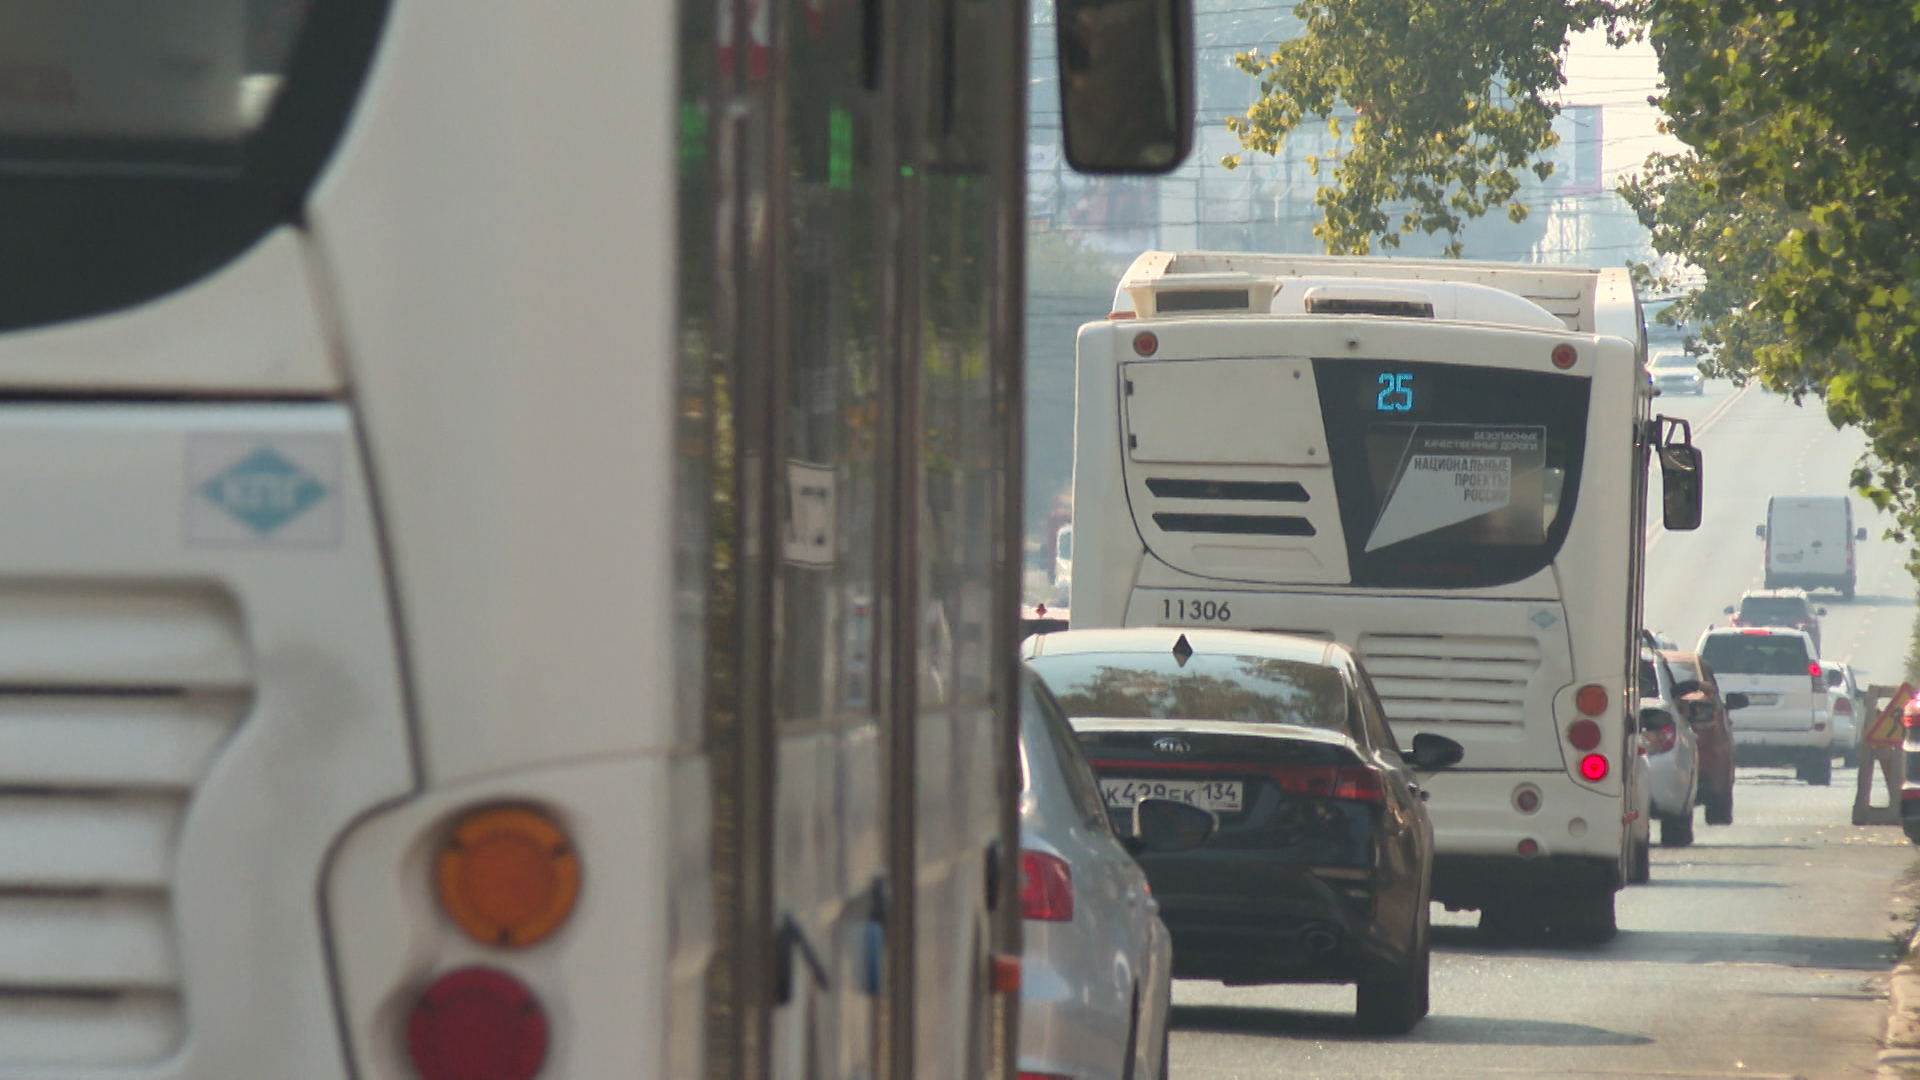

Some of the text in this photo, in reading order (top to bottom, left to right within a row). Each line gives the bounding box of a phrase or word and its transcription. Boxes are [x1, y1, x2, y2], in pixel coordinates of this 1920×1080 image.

[1377, 373, 1414, 411] 25
[1414, 457, 1509, 472] НАЦИОНАЛЬНЫЕ
[1455, 473, 1509, 486] ПРОЕКТЫ
[1163, 599, 1231, 621] 11306
[1157, 739, 1187, 753] KIA
[1202, 783, 1237, 801] 134
